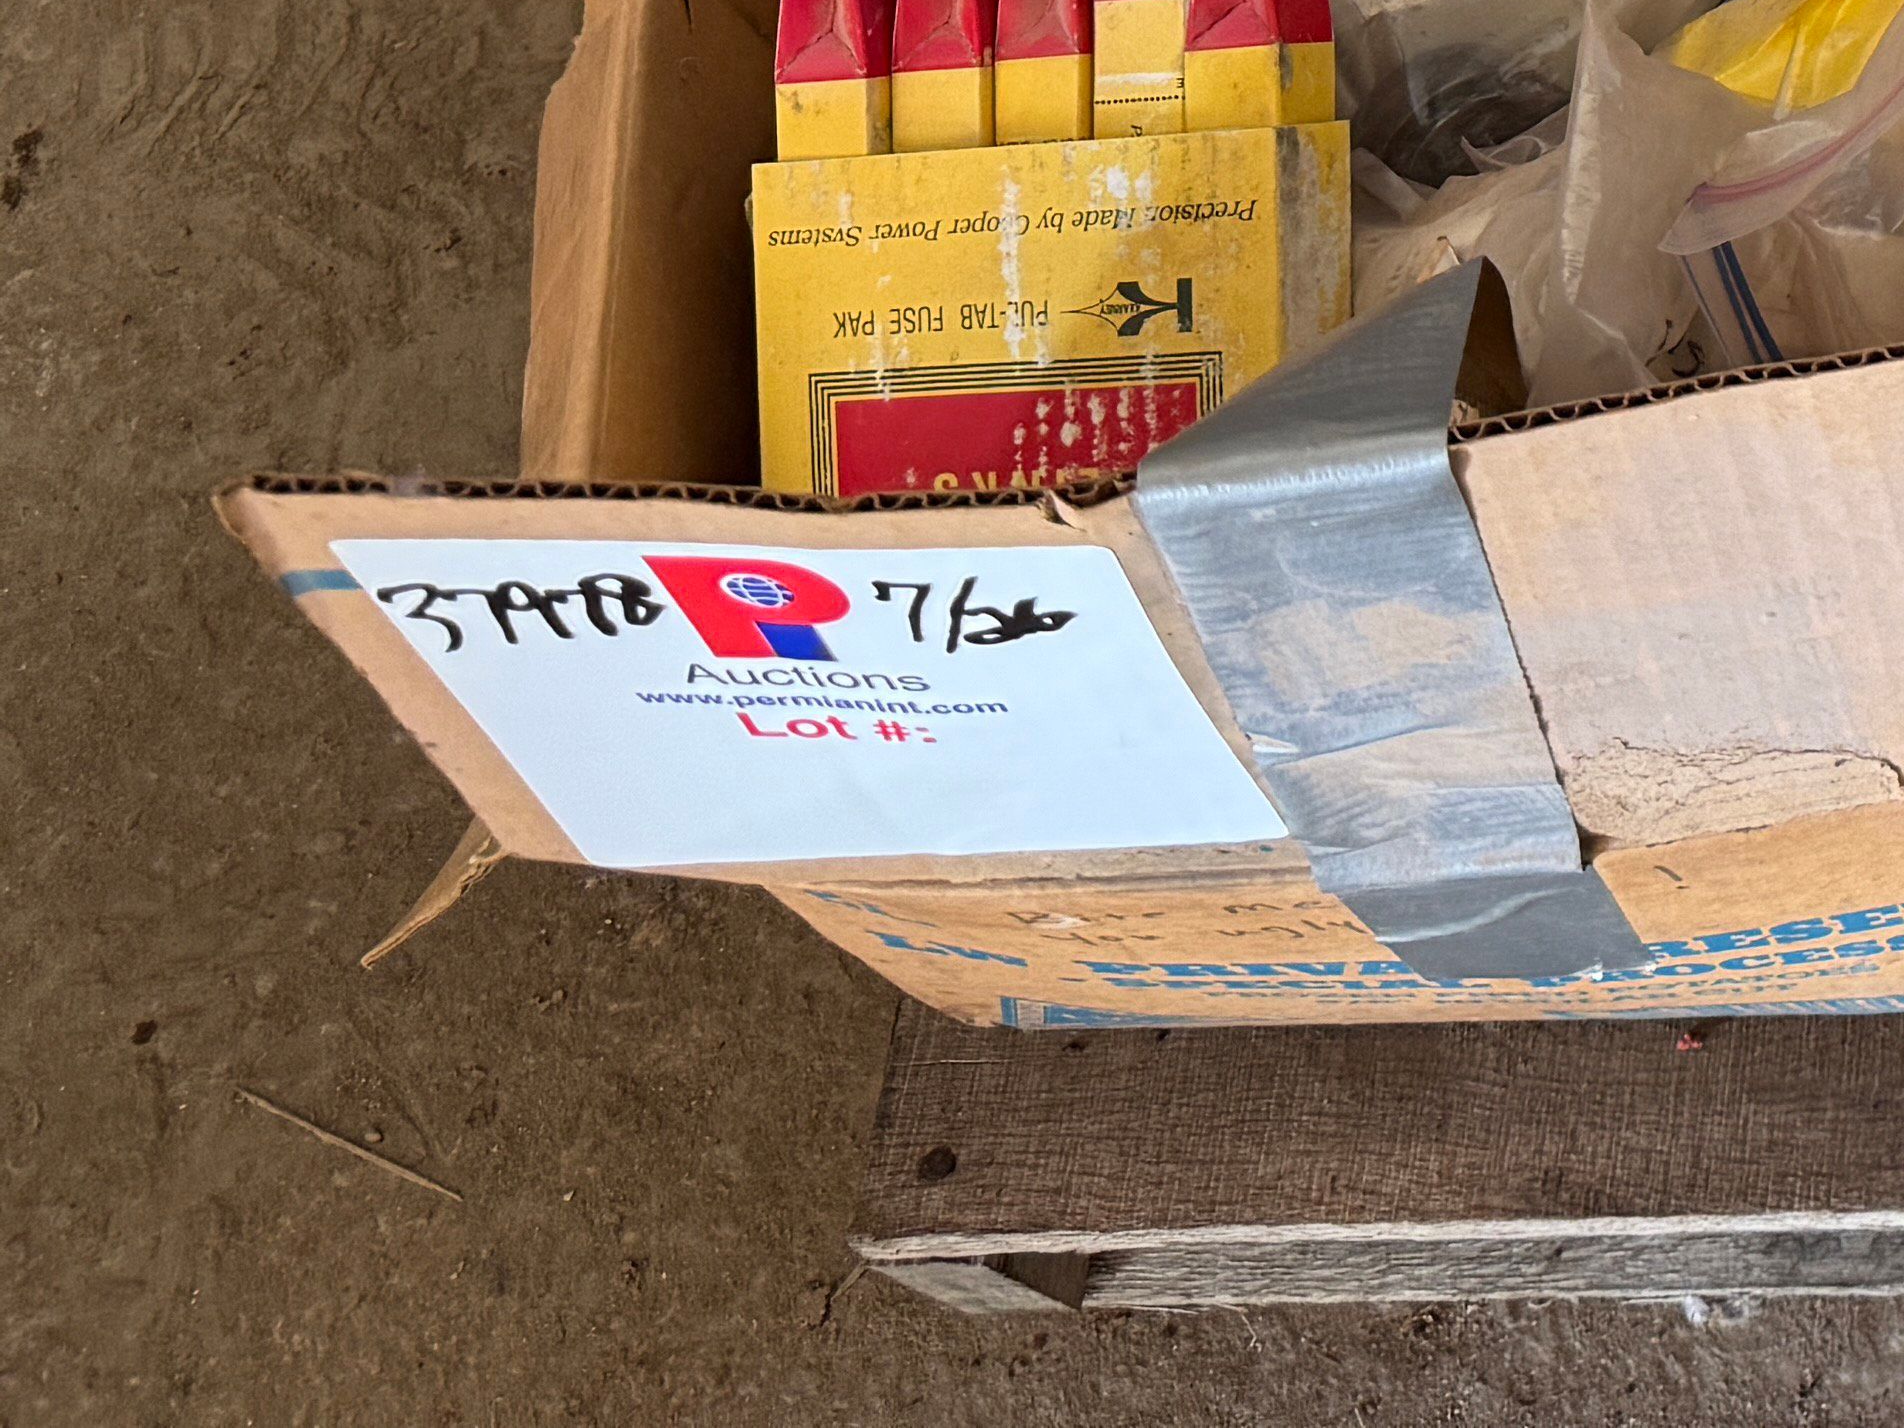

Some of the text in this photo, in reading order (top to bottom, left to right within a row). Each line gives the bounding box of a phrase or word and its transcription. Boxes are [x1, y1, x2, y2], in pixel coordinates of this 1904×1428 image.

[1036, 206, 1066, 232] by
[1144, 198, 1258, 223] Precision
[868, 219, 940, 242] Power
[833, 309, 875, 339] PAK
[889, 304, 944, 333] FUSE
[685, 662, 933, 694] Auctions
[635, 689, 1010, 718] www.permianint.com
[737, 713, 939, 745] Lot #:
[1072, 960, 1415, 978] PRIVA
